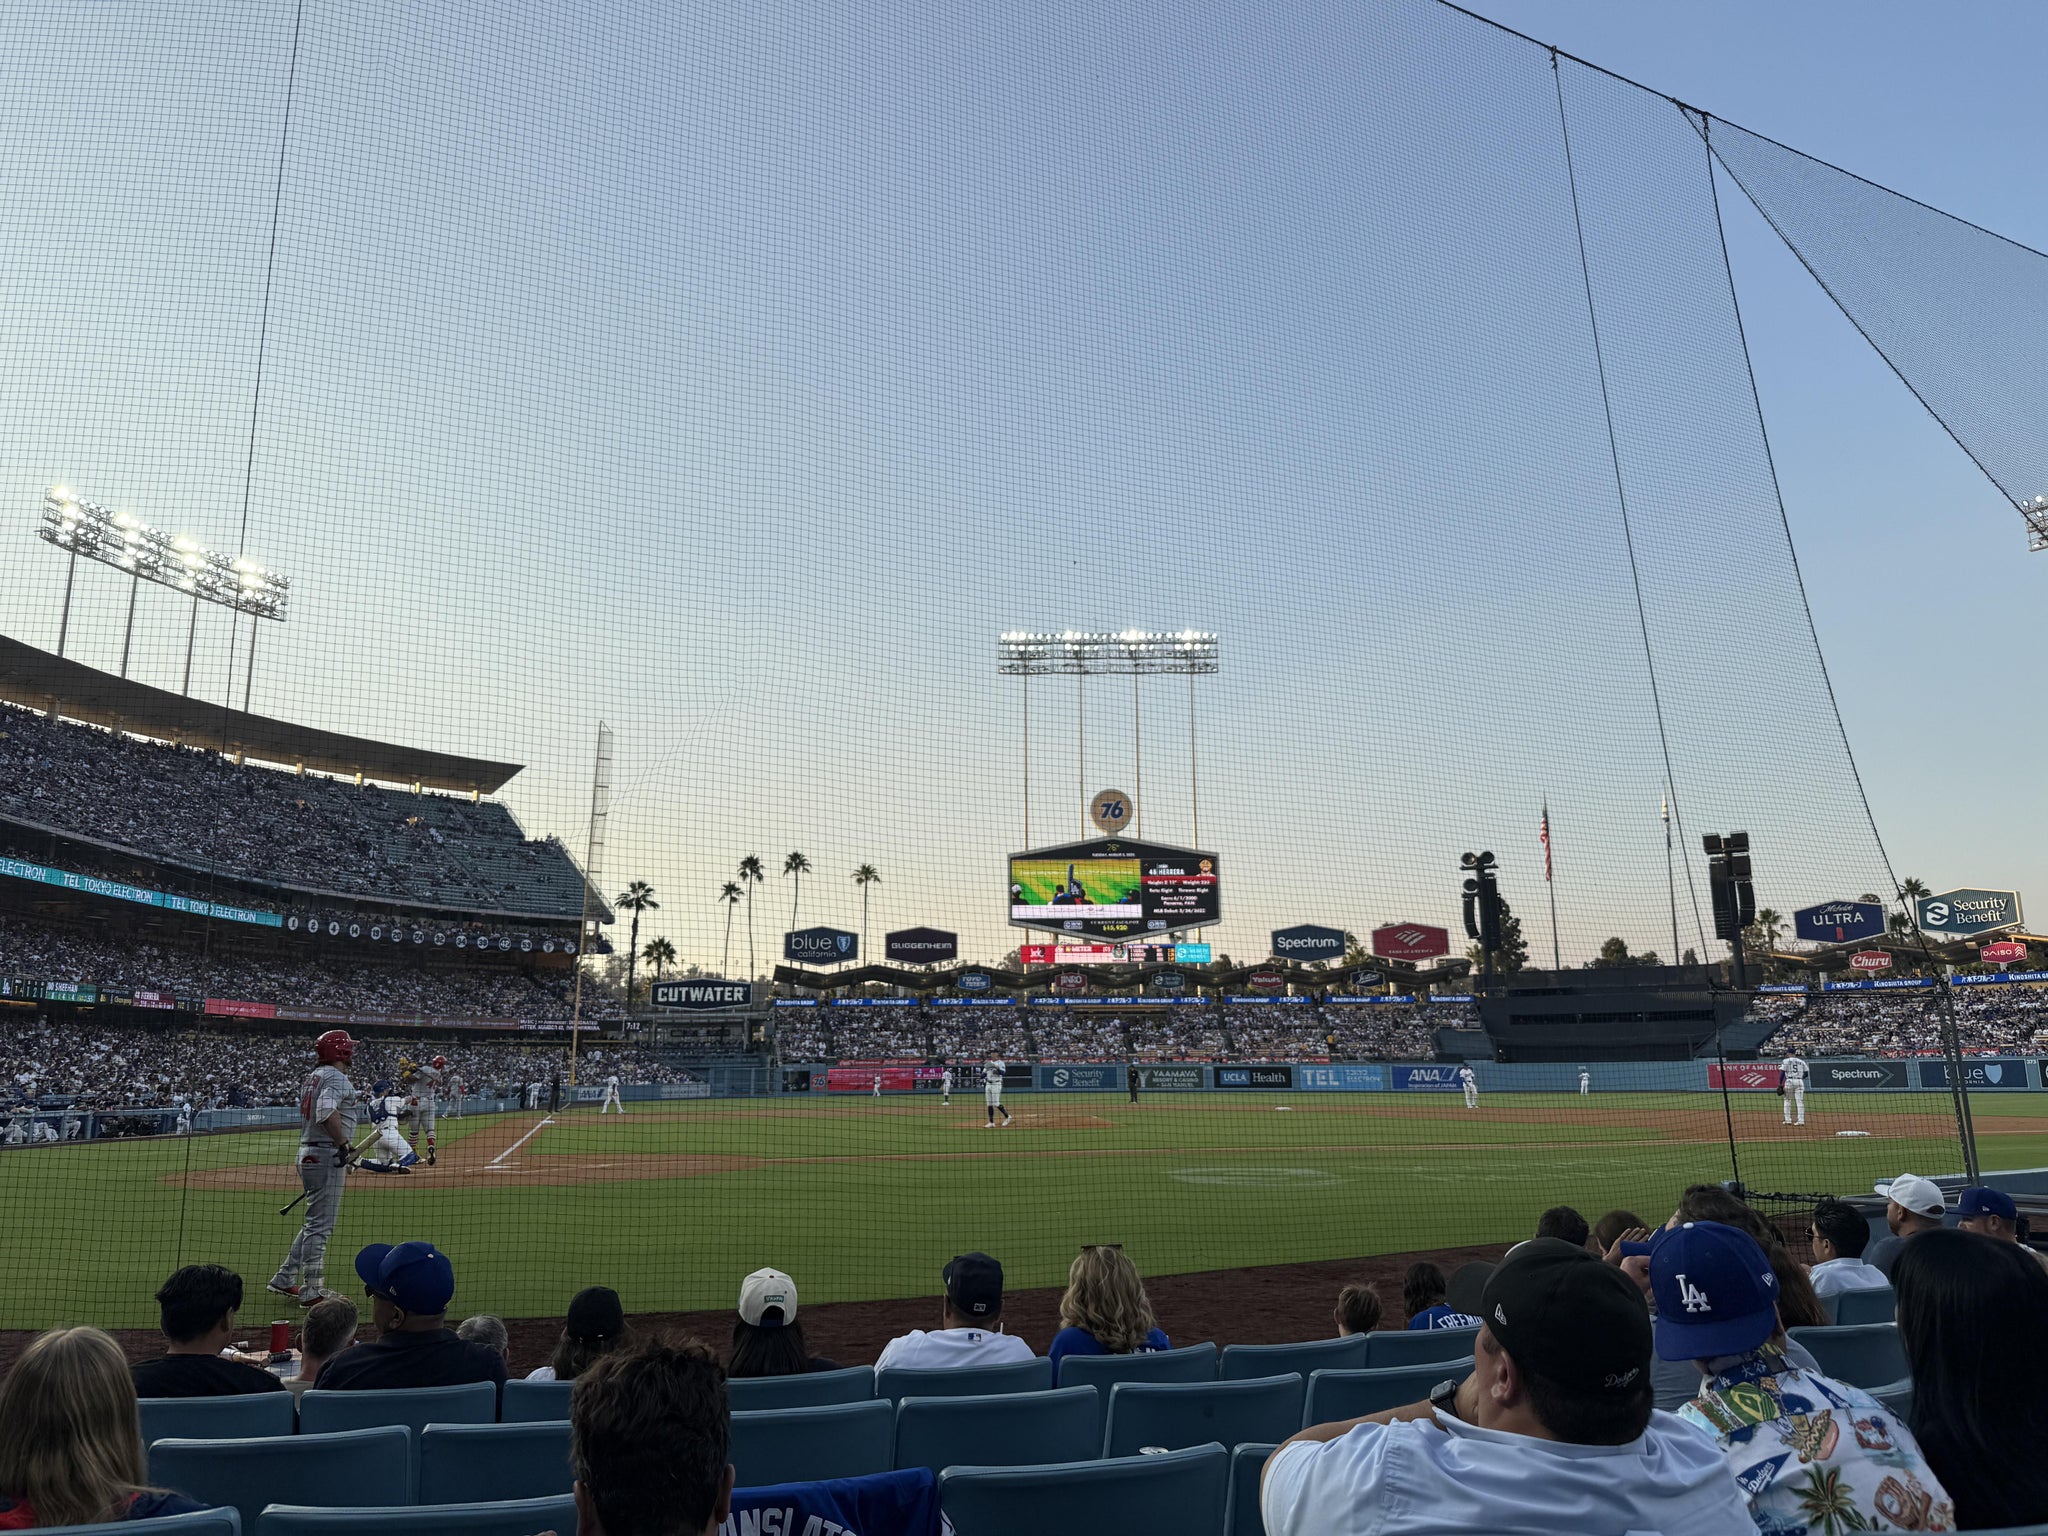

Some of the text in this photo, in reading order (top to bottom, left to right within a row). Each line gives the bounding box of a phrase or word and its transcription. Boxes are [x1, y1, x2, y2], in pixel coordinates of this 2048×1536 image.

[1101, 800, 1124, 819] 76
[64, 873, 153, 904] TEL TOKYO ELECTRON
[172, 897, 257, 923] TEL TOKYO ELECTRON
[1953, 898, 2008, 912] Security
[1813, 912, 1864, 926] ULTRA
[1956, 910, 2003, 925] Benefit
[791, 934, 832, 951] blue
[891, 942, 953, 950] GUGGENHEIM
[1277, 936, 1336, 951] Spectrum
[797, 949, 837, 959] california
[1983, 949, 2012, 957] DAISO
[1851, 955, 1890, 967] Churu
[1061, 976, 1082, 985] JINRO
[1969, 975, 1995, 983] 木下グループ
[2008, 973, 2040, 981] KINOSHITA
[55, 983, 79, 993] SHEEHAN
[1836, 981, 1862, 989] 木下グループ
[657, 986, 744, 1002] CUTWATER
[626, 1022, 641, 1030] 7:12
[1072, 1069, 1105, 1079] Security
[1791, 1064, 1799, 1074] 5
[1831, 1069, 1881, 1079] Spectrum
[1223, 1073, 1247, 1082] UCLA
[1252, 1072, 1286, 1083] Health
[1302, 1070, 1340, 1086] TEL
[1408, 1069, 1440, 1081] ANA
[813, 1077, 825, 1086] 76
[1072, 1078, 1100, 1087] Benefit
[1675, 1274, 1712, 1313] LA
[1604, 1367, 1640, 1388] Dodgers
[1718, 1375, 1733, 1388] LA
[1747, 1461, 1775, 1493] Dodgers
